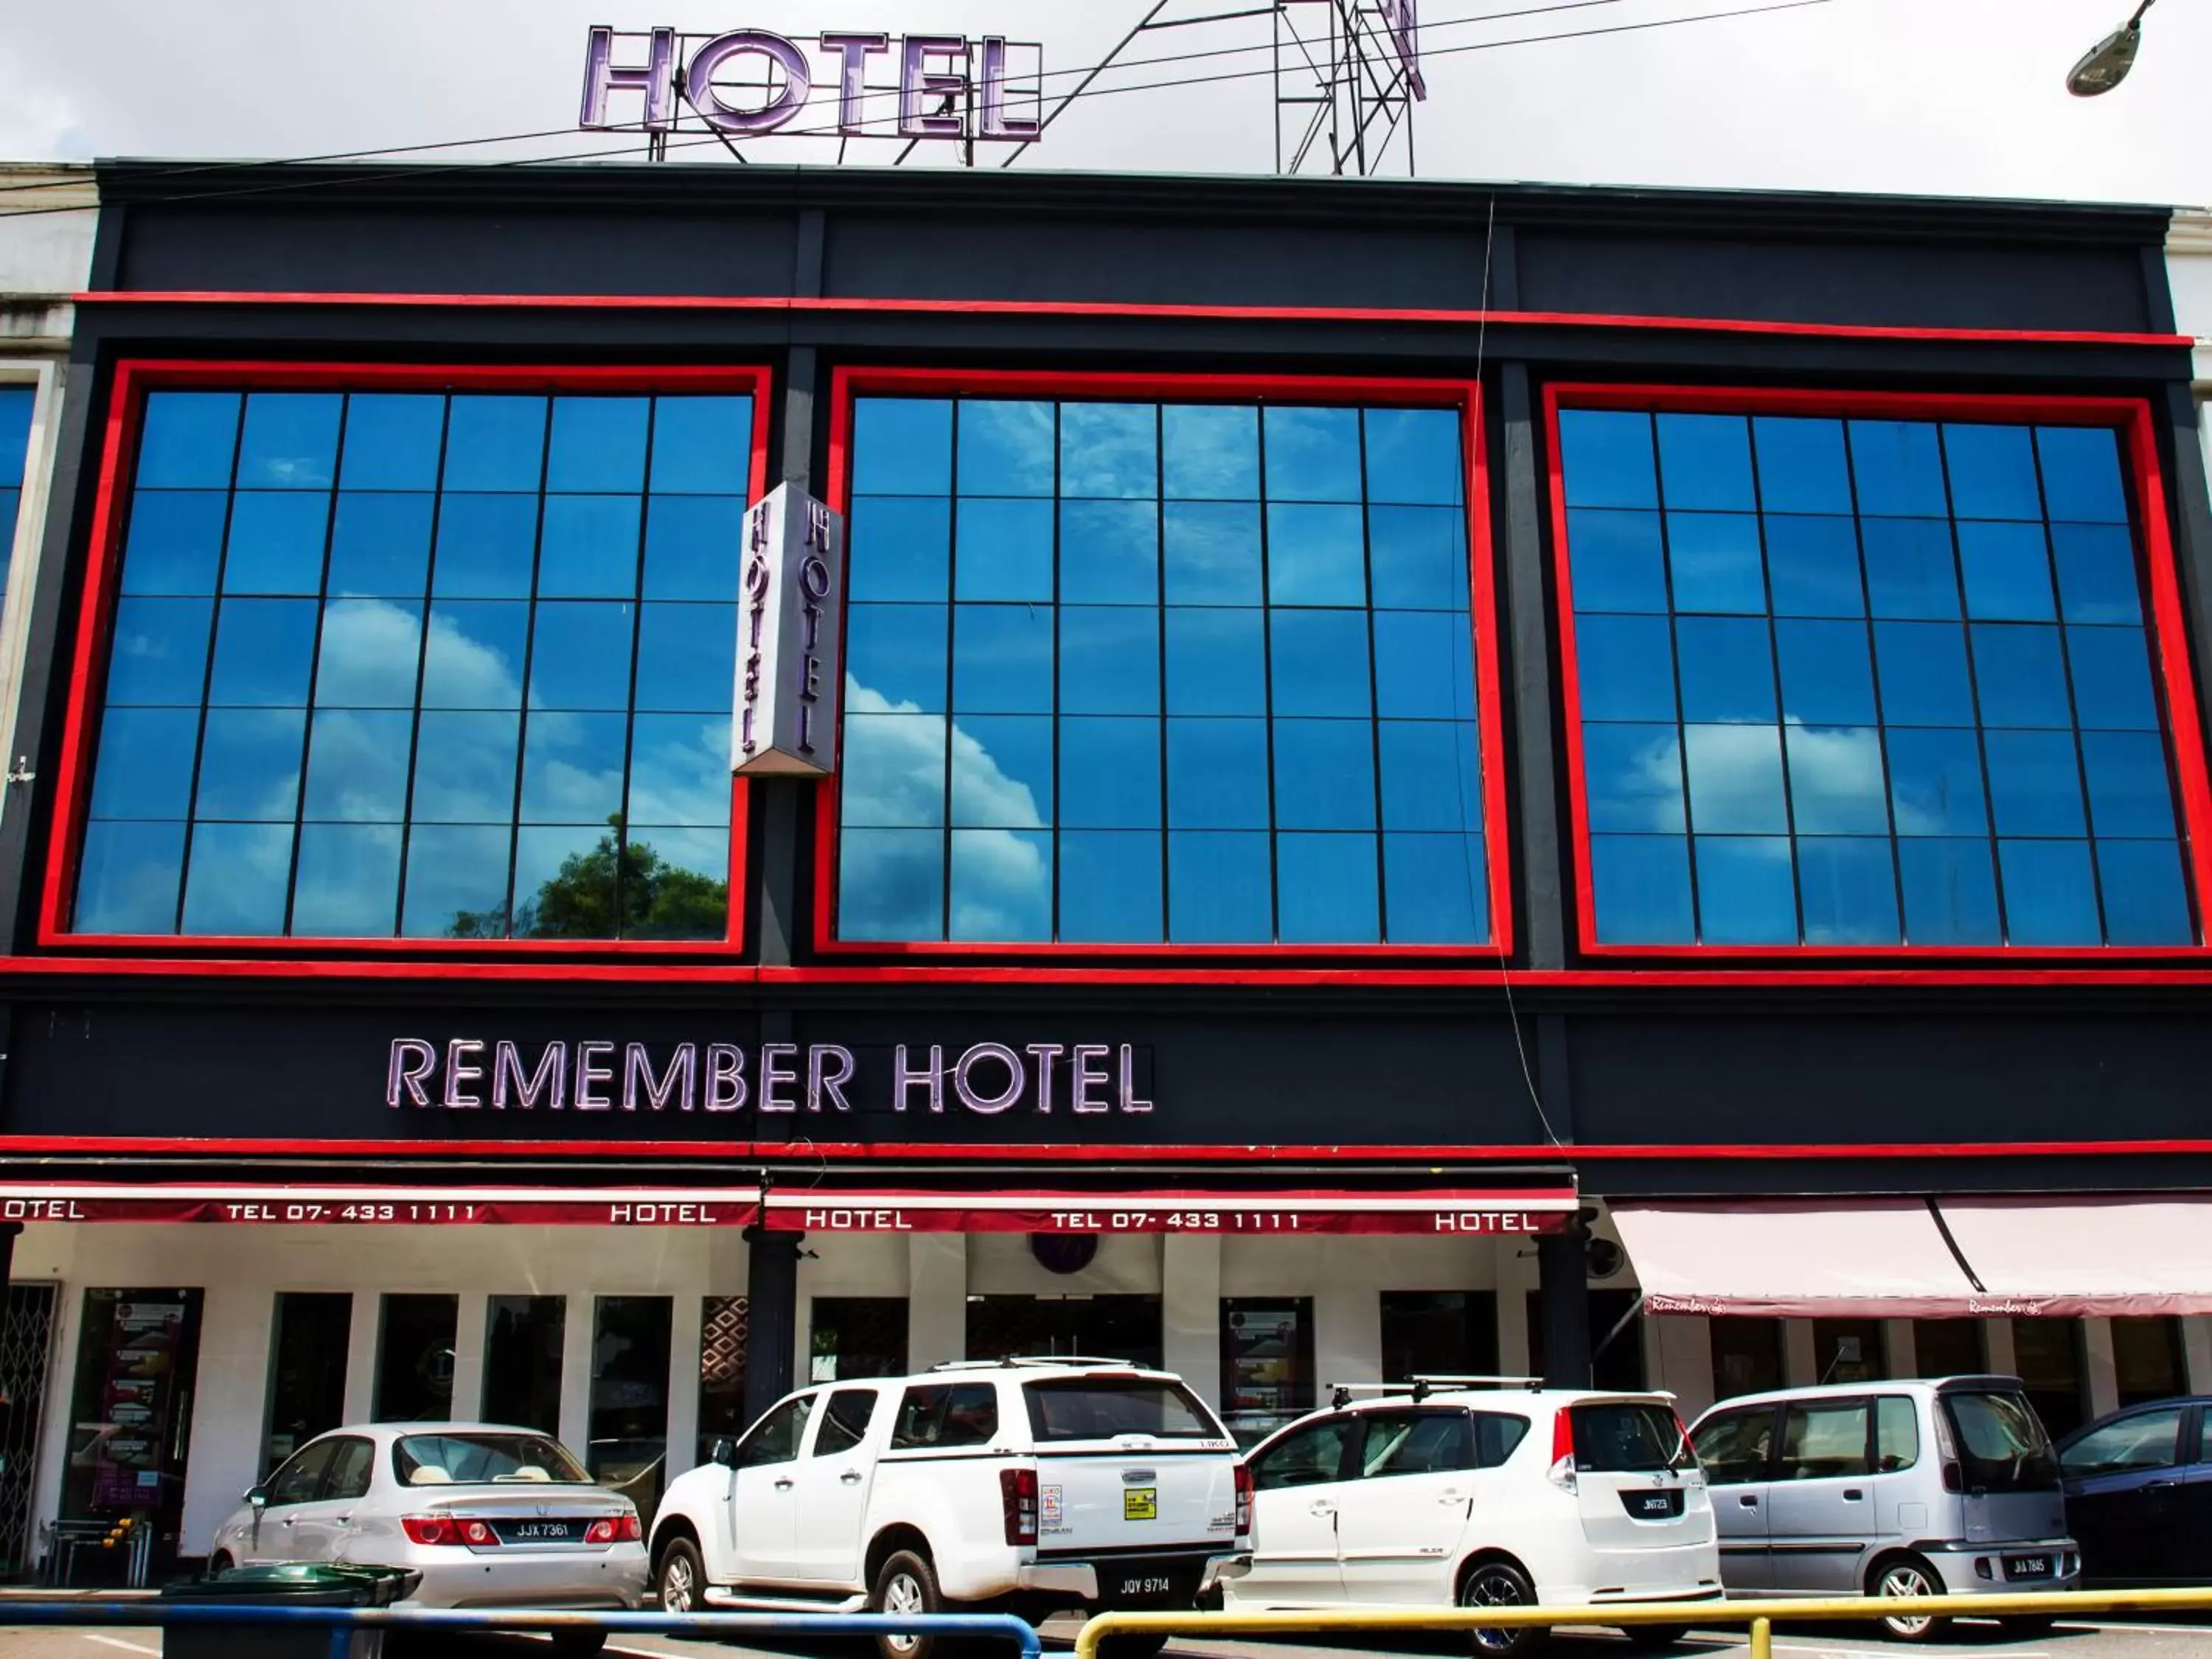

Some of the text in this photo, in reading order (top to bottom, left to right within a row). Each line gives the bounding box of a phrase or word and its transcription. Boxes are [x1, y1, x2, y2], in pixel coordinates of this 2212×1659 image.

[578, 25, 1040, 140] HOTEL
[742, 501, 770, 754] HOTEL
[798, 500, 831, 754] HOTEL
[386, 1037, 1155, 1114] REMEMBER HOTEL
[227, 1205, 276, 1219] TEL
[341, 1205, 394, 1220] 433
[410, 1206, 474, 1219] 1111
[611, 1204, 717, 1222] HOTEL
[806, 1210, 912, 1228] HOTEL
[1051, 1213, 1102, 1228] TEL
[1167, 1213, 1219, 1228] 433
[1234, 1213, 1298, 1228] 1111
[1433, 1213, 1539, 1231] HOTEL
[540, 1523, 569, 1536] 7361
[1121, 1578, 1169, 1594] JQY 9714
